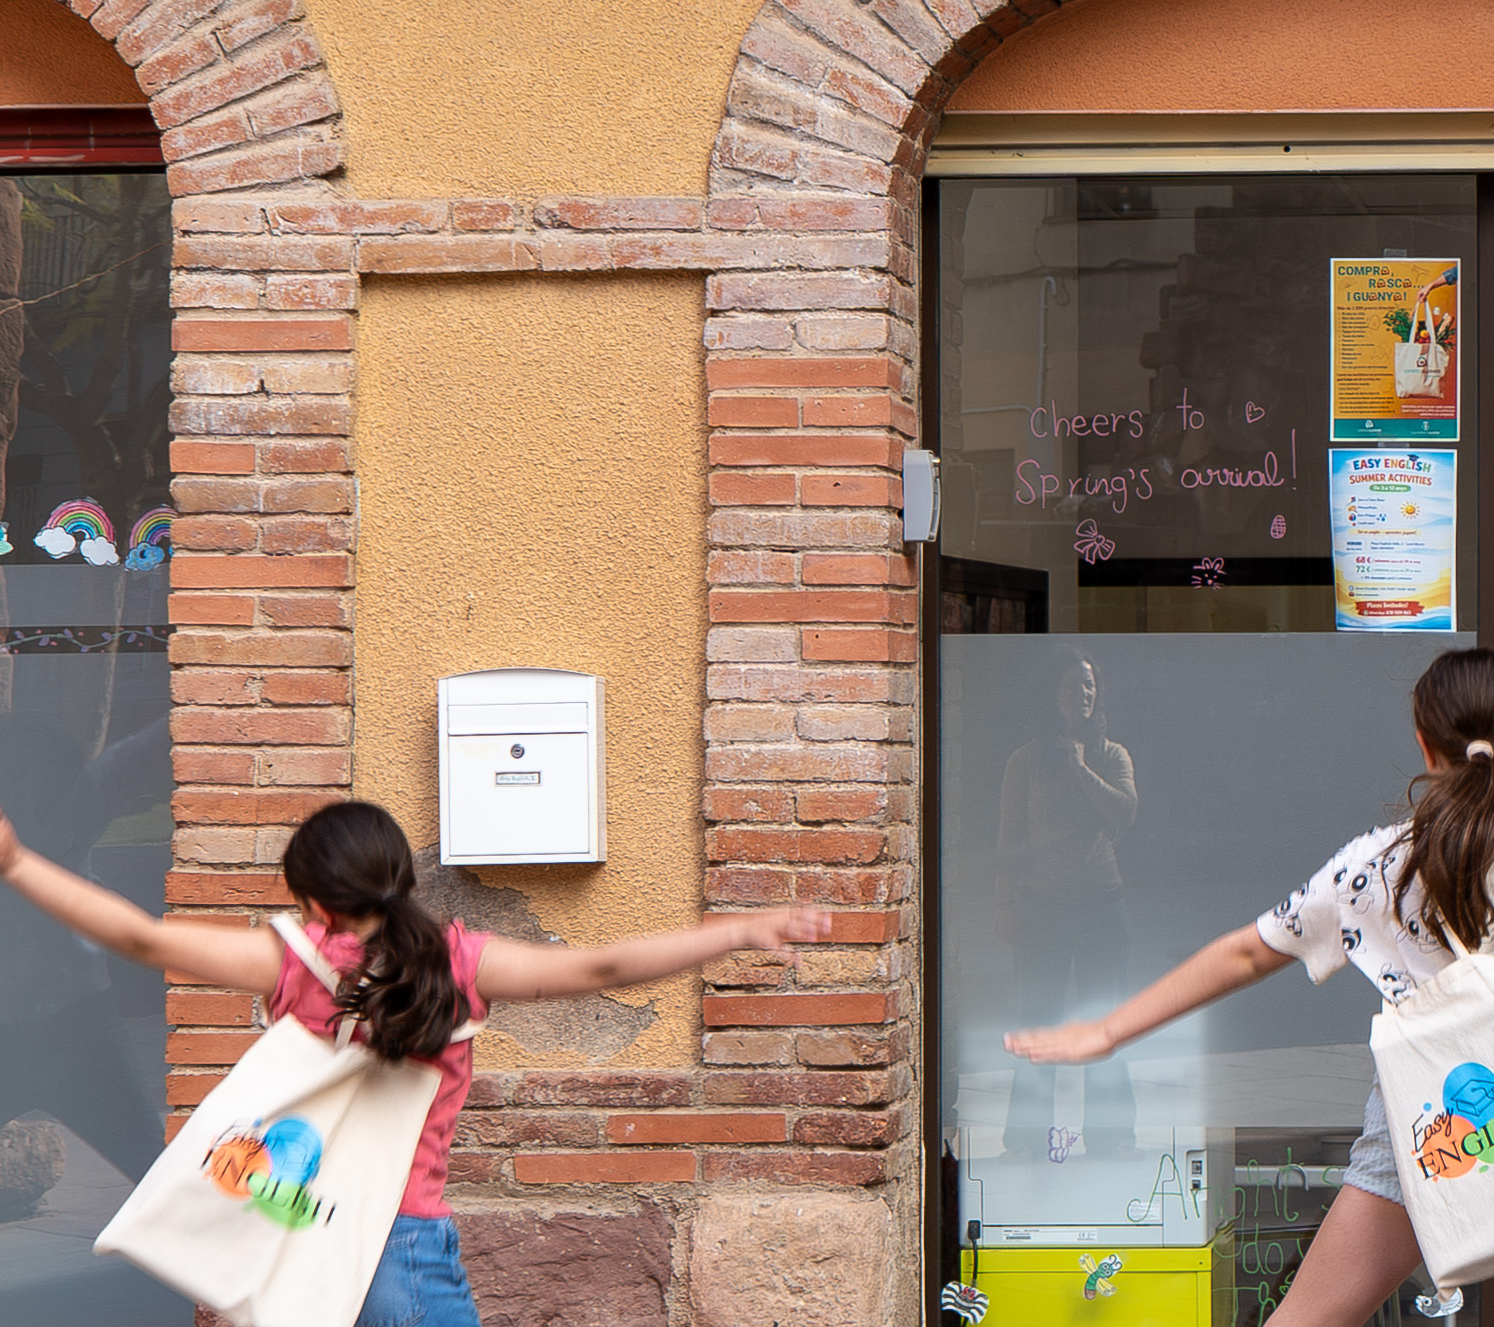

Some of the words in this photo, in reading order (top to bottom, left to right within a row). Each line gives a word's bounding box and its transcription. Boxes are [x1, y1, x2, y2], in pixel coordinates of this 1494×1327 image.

[1030, 399, 1144, 438] Cheers
[1175, 387, 1205, 430] to
[1015, 459, 1153, 513] Spring's
[1349, 473, 1386, 485] SUMMER
[1388, 473, 1433, 486] ACTIVITIES
[1353, 458, 1381, 471] EASY
[1384, 458, 1432, 472] ENGLISH
[1411, 1107, 1455, 1154] Easy
